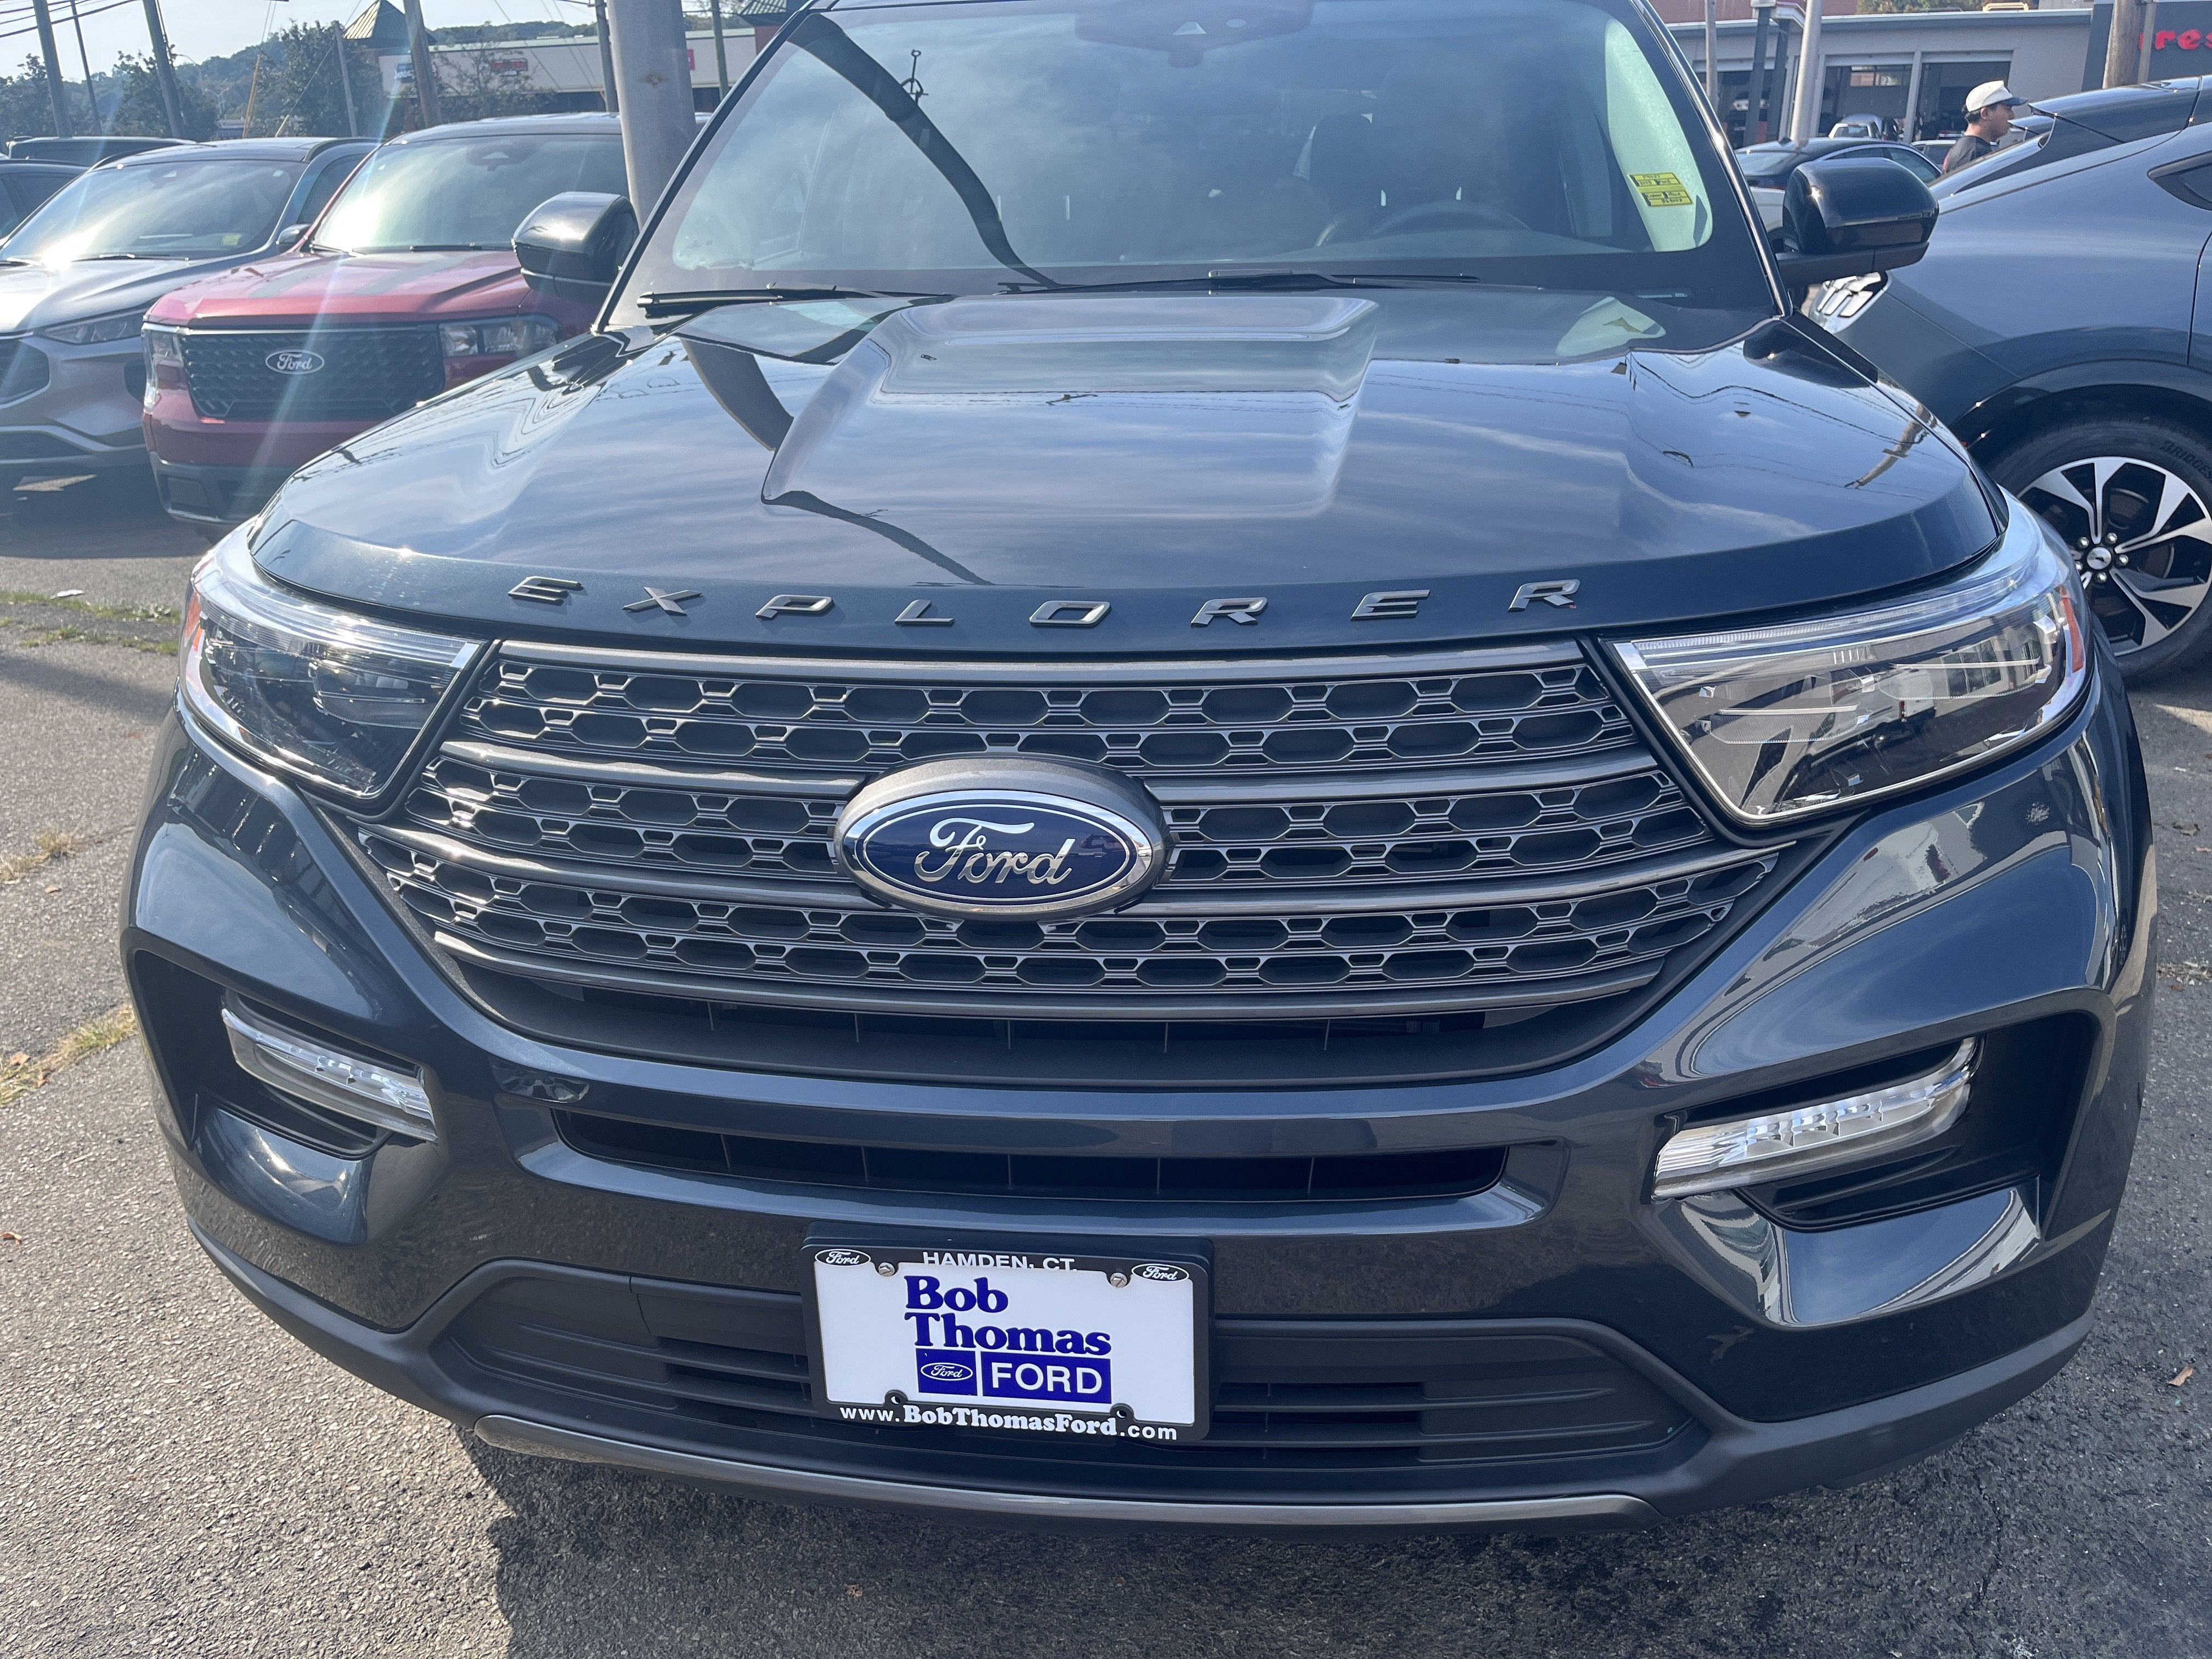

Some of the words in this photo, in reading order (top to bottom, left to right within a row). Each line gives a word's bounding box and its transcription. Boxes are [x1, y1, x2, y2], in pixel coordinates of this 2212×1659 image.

[277, 353, 312, 370] Ford
[508, 575, 1581, 627] EXPLORER
[915, 817, 1075, 885] Ford
[825, 1250, 860, 1266] Ford
[923, 1251, 1034, 1269] HAMDEN,
[1143, 1265, 1178, 1281] Ford
[904, 1276, 1008, 1313] Bob
[904, 1312, 1112, 1356] Thomas
[930, 1364, 963, 1380] Ford
[992, 1362, 1102, 1395] FORD
[839, 1404, 1177, 1440] www.BobThomasFord.com
